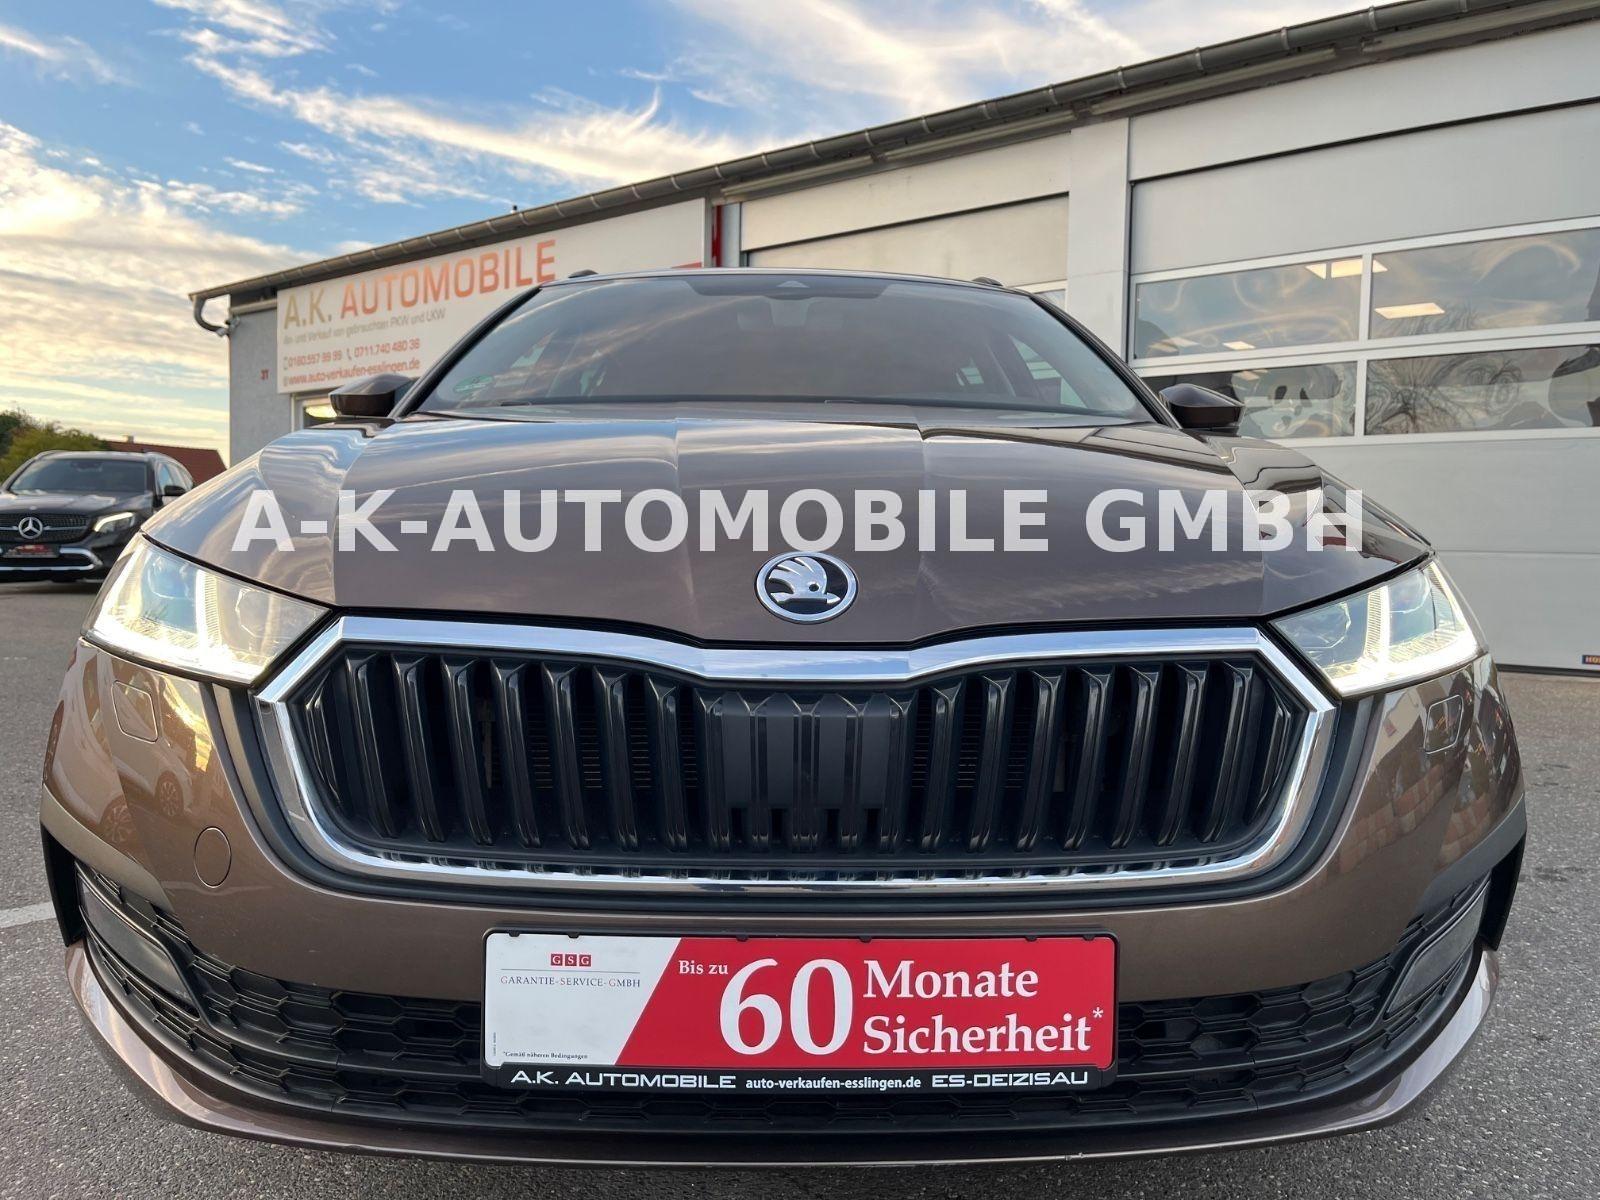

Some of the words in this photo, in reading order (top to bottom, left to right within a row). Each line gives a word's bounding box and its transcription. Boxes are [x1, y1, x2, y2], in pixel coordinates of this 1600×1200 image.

[283, 287, 332, 329] A.K.
[341, 240, 556, 319] AUTOMOBILE
[390, 314, 409, 327] PKW
[426, 307, 446, 322] LKW
[551, 954, 591, 967] GSG
[500, 975, 641, 988] GARANTIE-SERVICE-GMBH
[863, 960, 1039, 999] Monate
[678, 960, 704, 975] Bis
[708, 963, 729, 976] zu
[719, 958, 853, 1056] 60
[510, 1070, 559, 1085] A.K.
[564, 1071, 736, 1089] AUTOMOBILE
[745, 1075, 921, 1092] auto-verkaufen-esslingen.de
[931, 1071, 1088, 1088] ES-DEIZISAU
